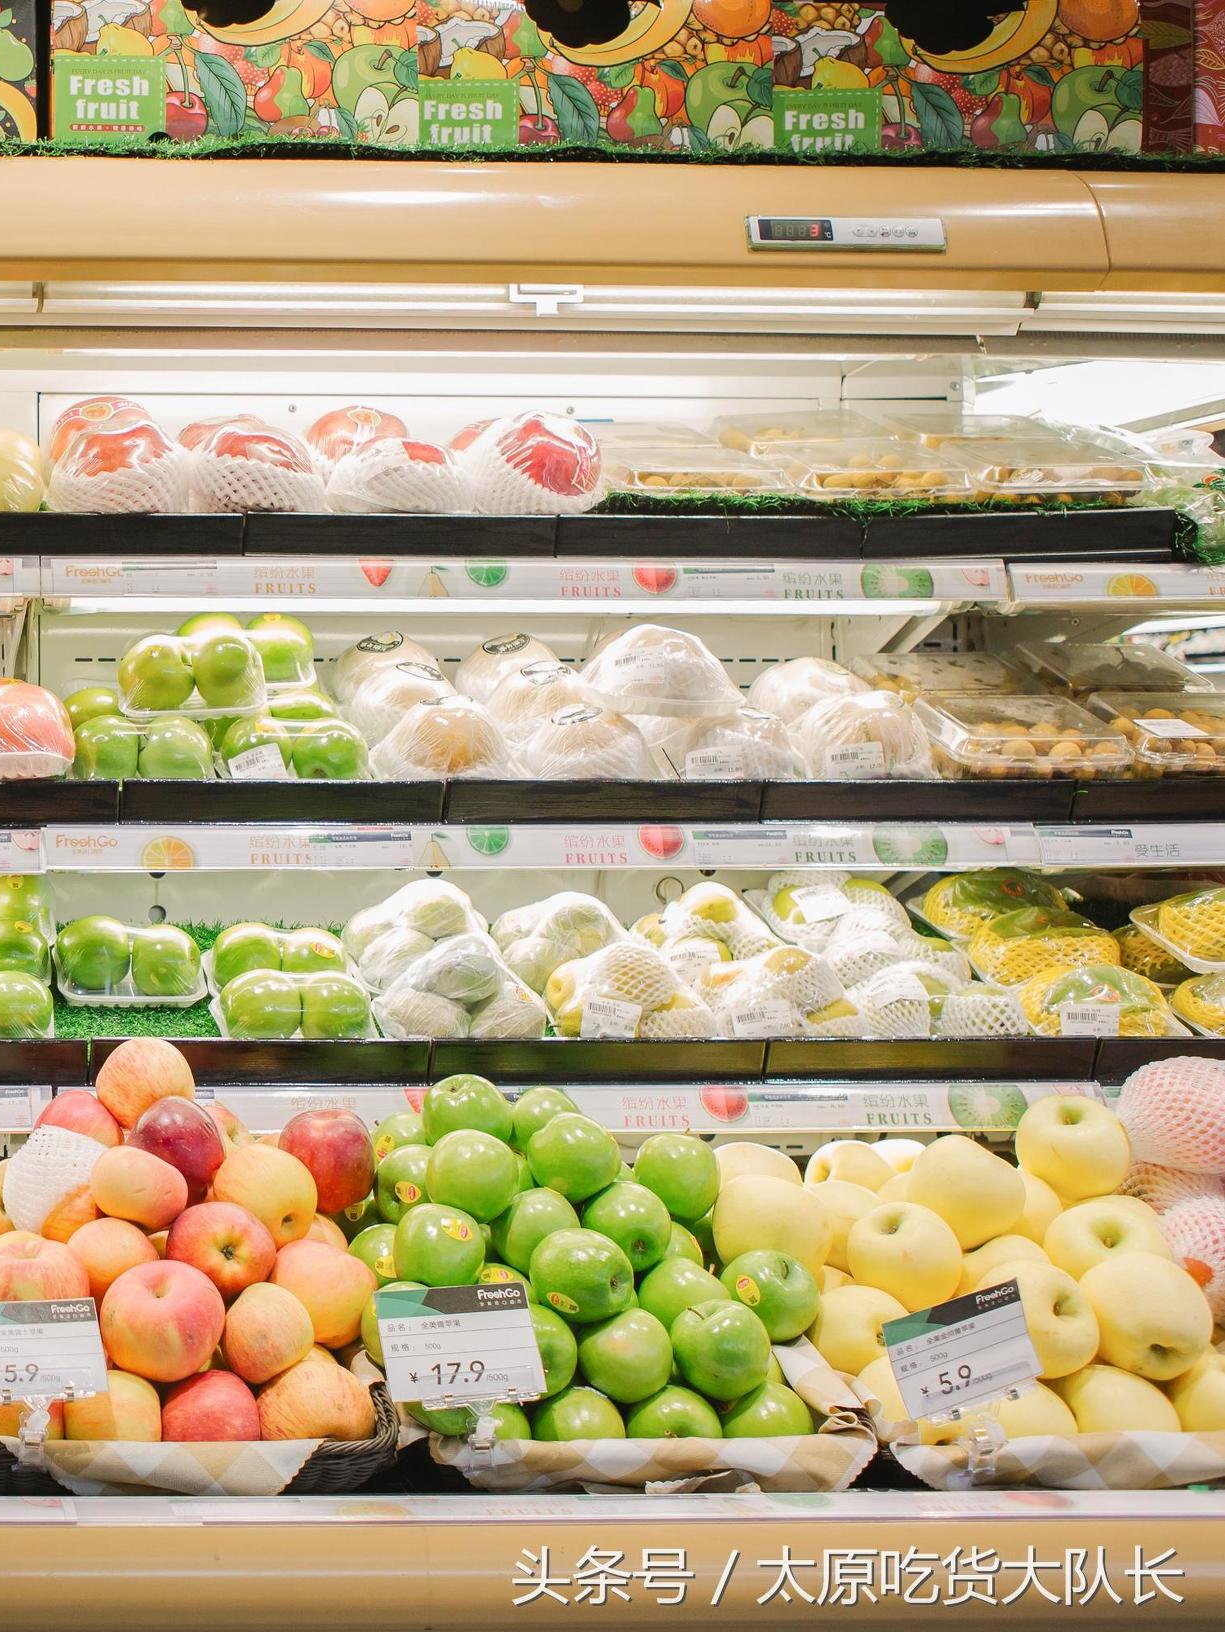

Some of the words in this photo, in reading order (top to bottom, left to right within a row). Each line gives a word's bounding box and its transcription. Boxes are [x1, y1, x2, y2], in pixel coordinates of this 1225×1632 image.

[70, 75, 150, 96] Fresh
[76, 98, 140, 120] fruit
[424, 99, 503, 120] Fresh
[785, 109, 866, 131] Fresh
[430, 123, 493, 145] fruit
[790, 132, 855, 153] fruit
[253, 582, 317, 594] FRUITS
[560, 586, 622, 598] FRUITS
[783, 588, 844, 600] FRUITS
[54, 834, 119, 847] FreshGo
[250, 853, 313, 865] FRUITS
[564, 852, 628, 864] FRUITS
[794, 851, 857, 863] FRUITS
[623, 1114, 690, 1128] FRUITS
[866, 1112, 933, 1125] FRUITS
[477, 1288, 521, 1300] FreshGo
[975, 1285, 1015, 1306] FreshGo
[50, 1304, 90, 1314] FreshGo
[4, 1363, 39, 1383] 5.9
[409, 1372, 419, 1383] ¥
[431, 1360, 486, 1386] 17.9
[939, 1364, 972, 1395] 5.9
